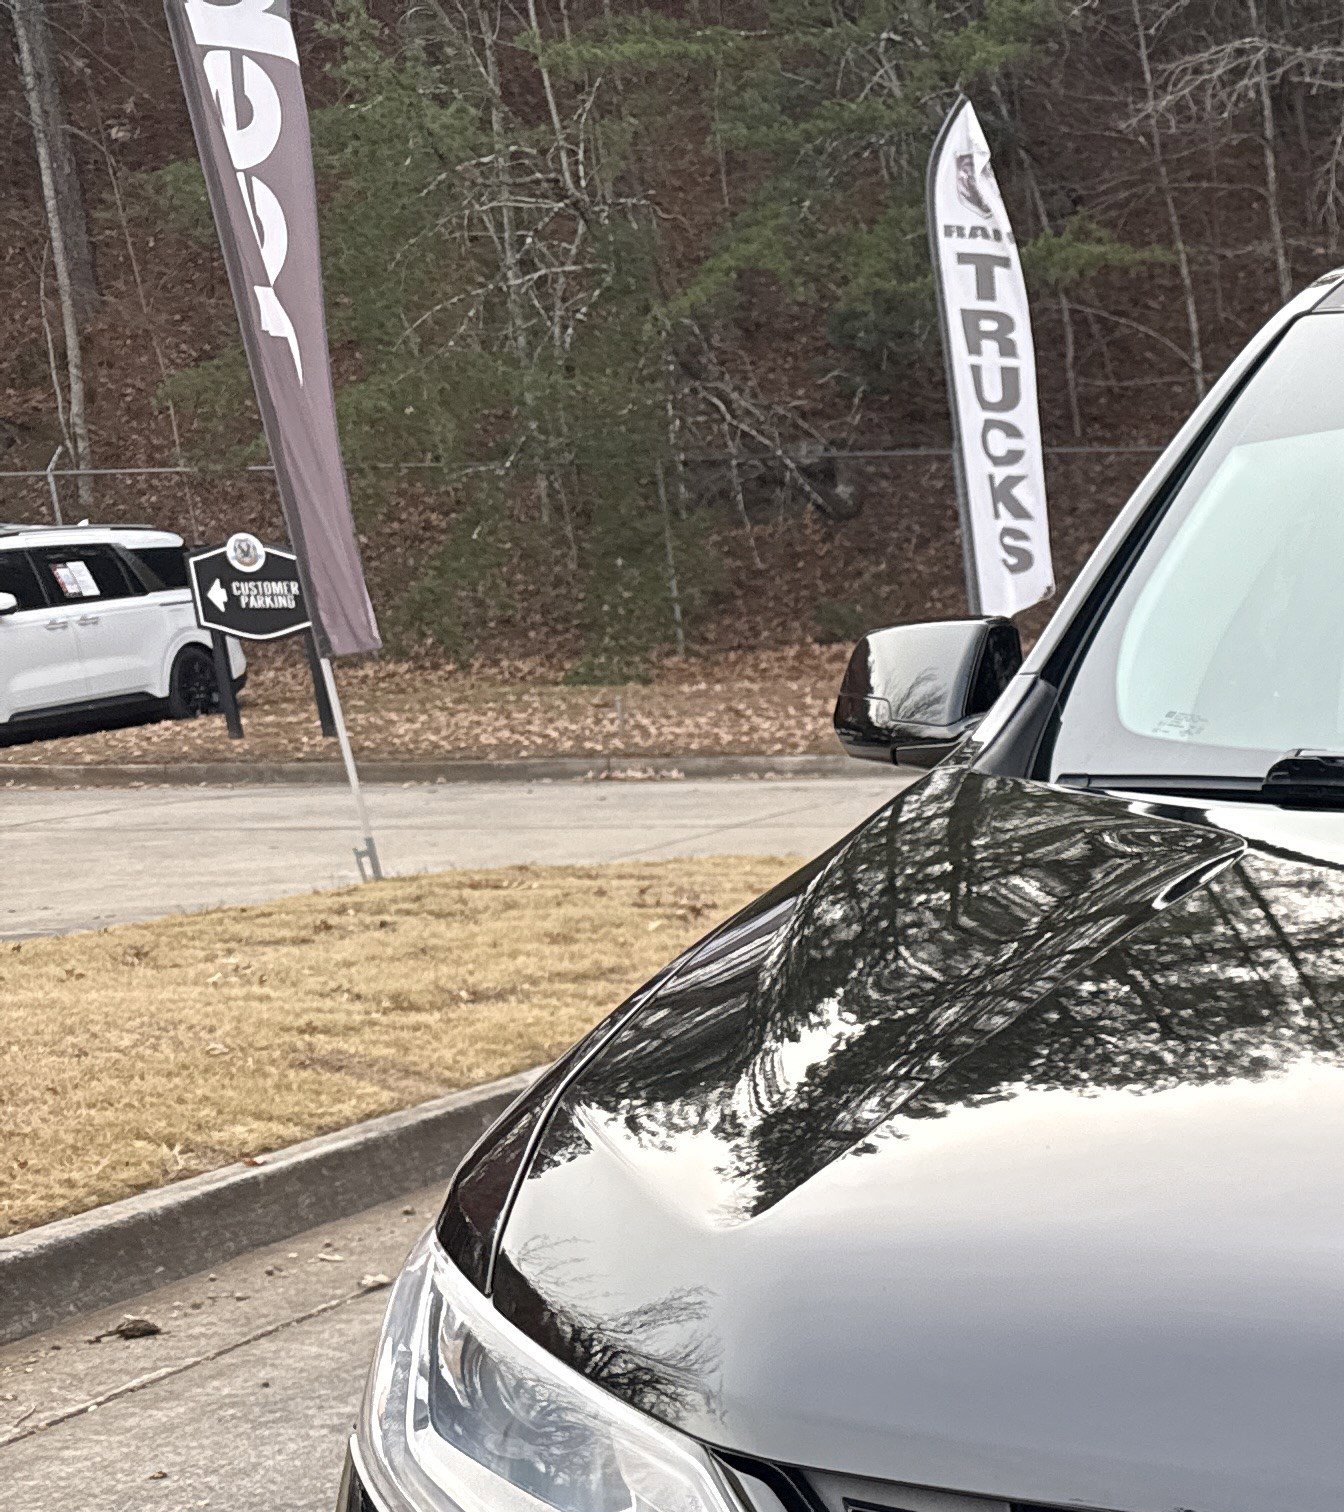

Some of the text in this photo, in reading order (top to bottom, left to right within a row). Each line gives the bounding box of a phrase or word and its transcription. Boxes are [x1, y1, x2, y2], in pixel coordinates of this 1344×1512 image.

[956, 251, 1036, 575] TRUCKS
[231, 581, 300, 596] CUSTOMER
[240, 595, 297, 609] PARKING
